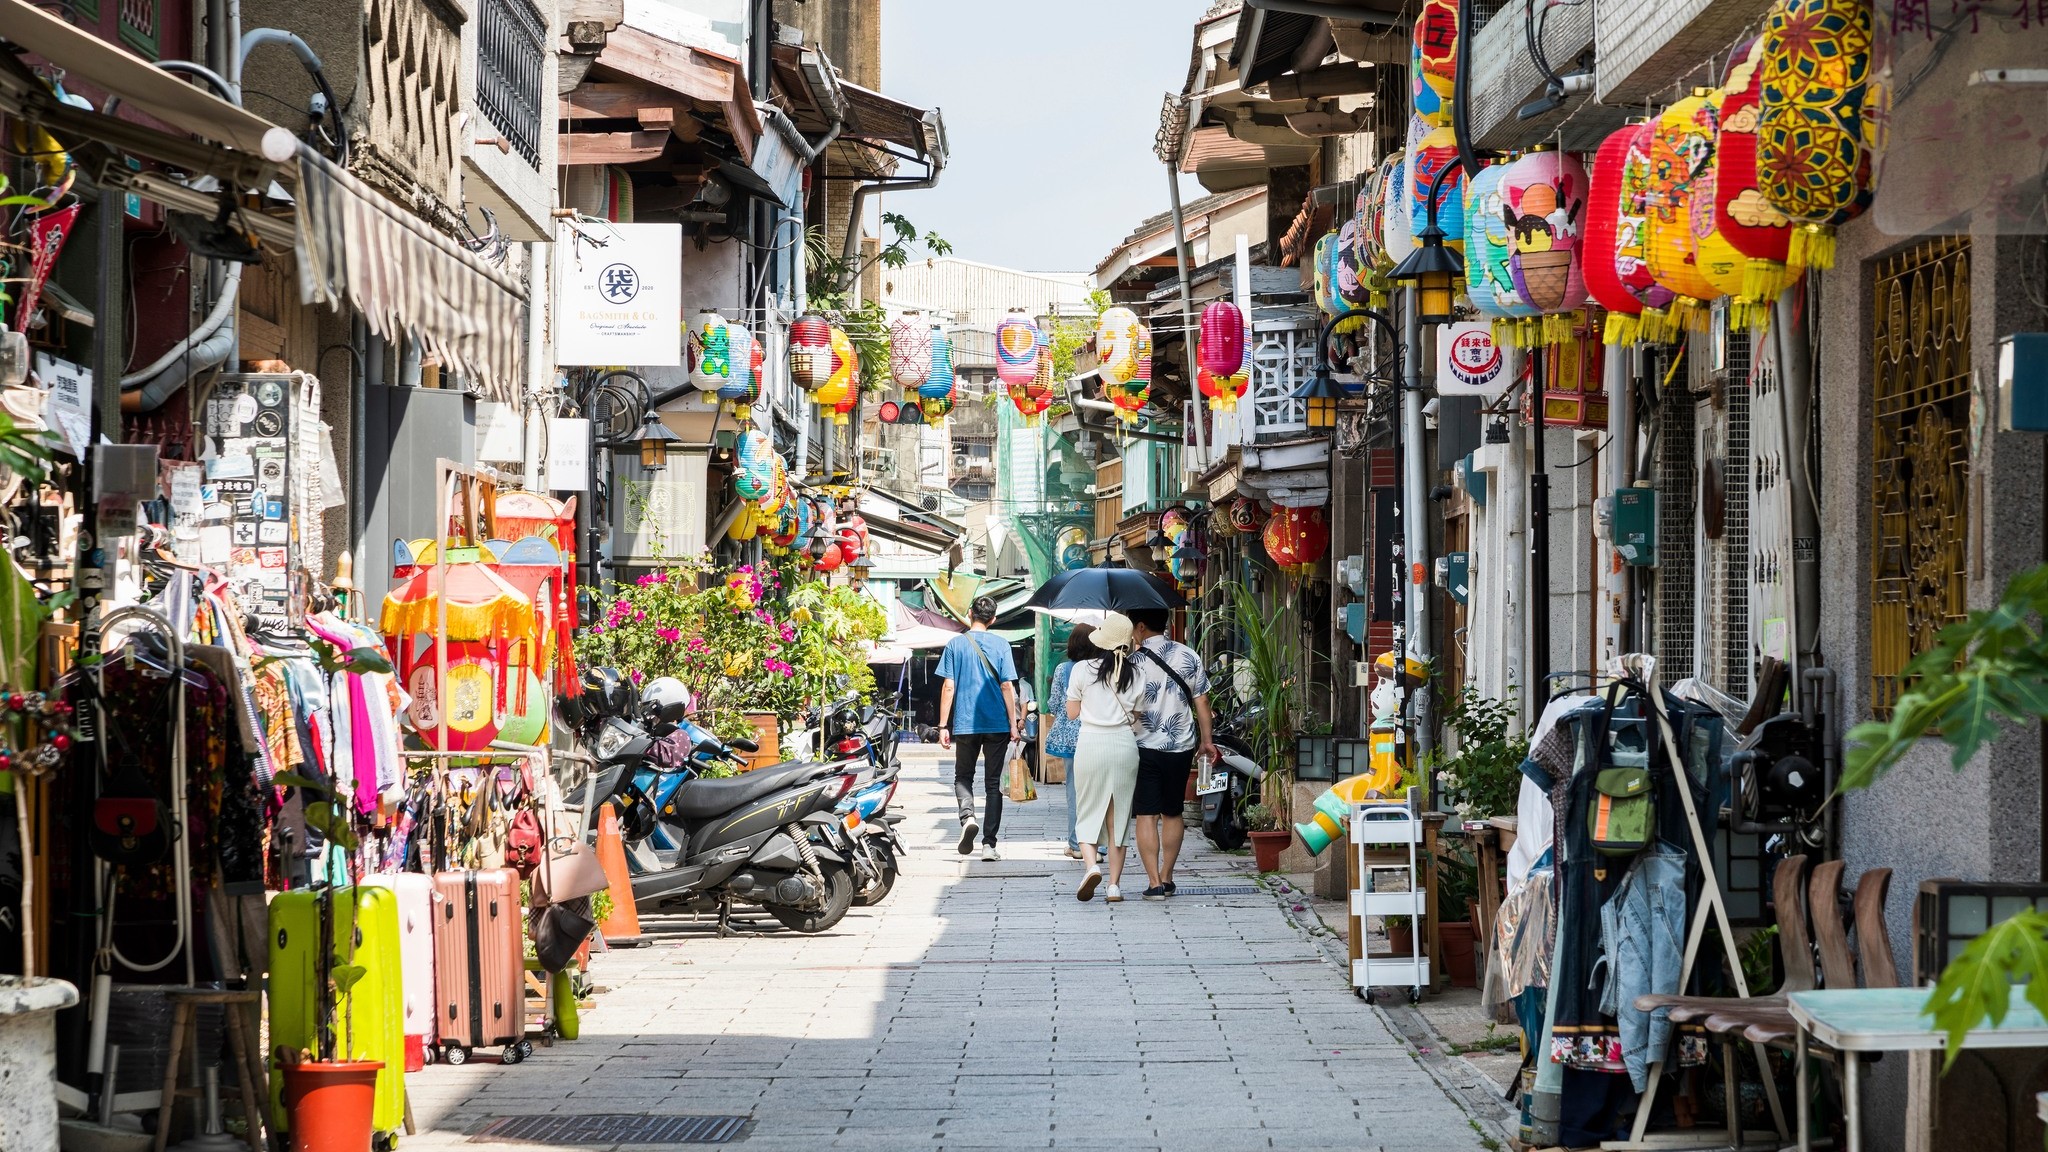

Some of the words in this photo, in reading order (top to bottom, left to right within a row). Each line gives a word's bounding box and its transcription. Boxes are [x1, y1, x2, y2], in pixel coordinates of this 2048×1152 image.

[605, 269, 633, 297] 袋
[633, 311, 639, 320] &
[1461, 338, 1491, 347] 錢來也
[1470, 348, 1481, 363] 商店
